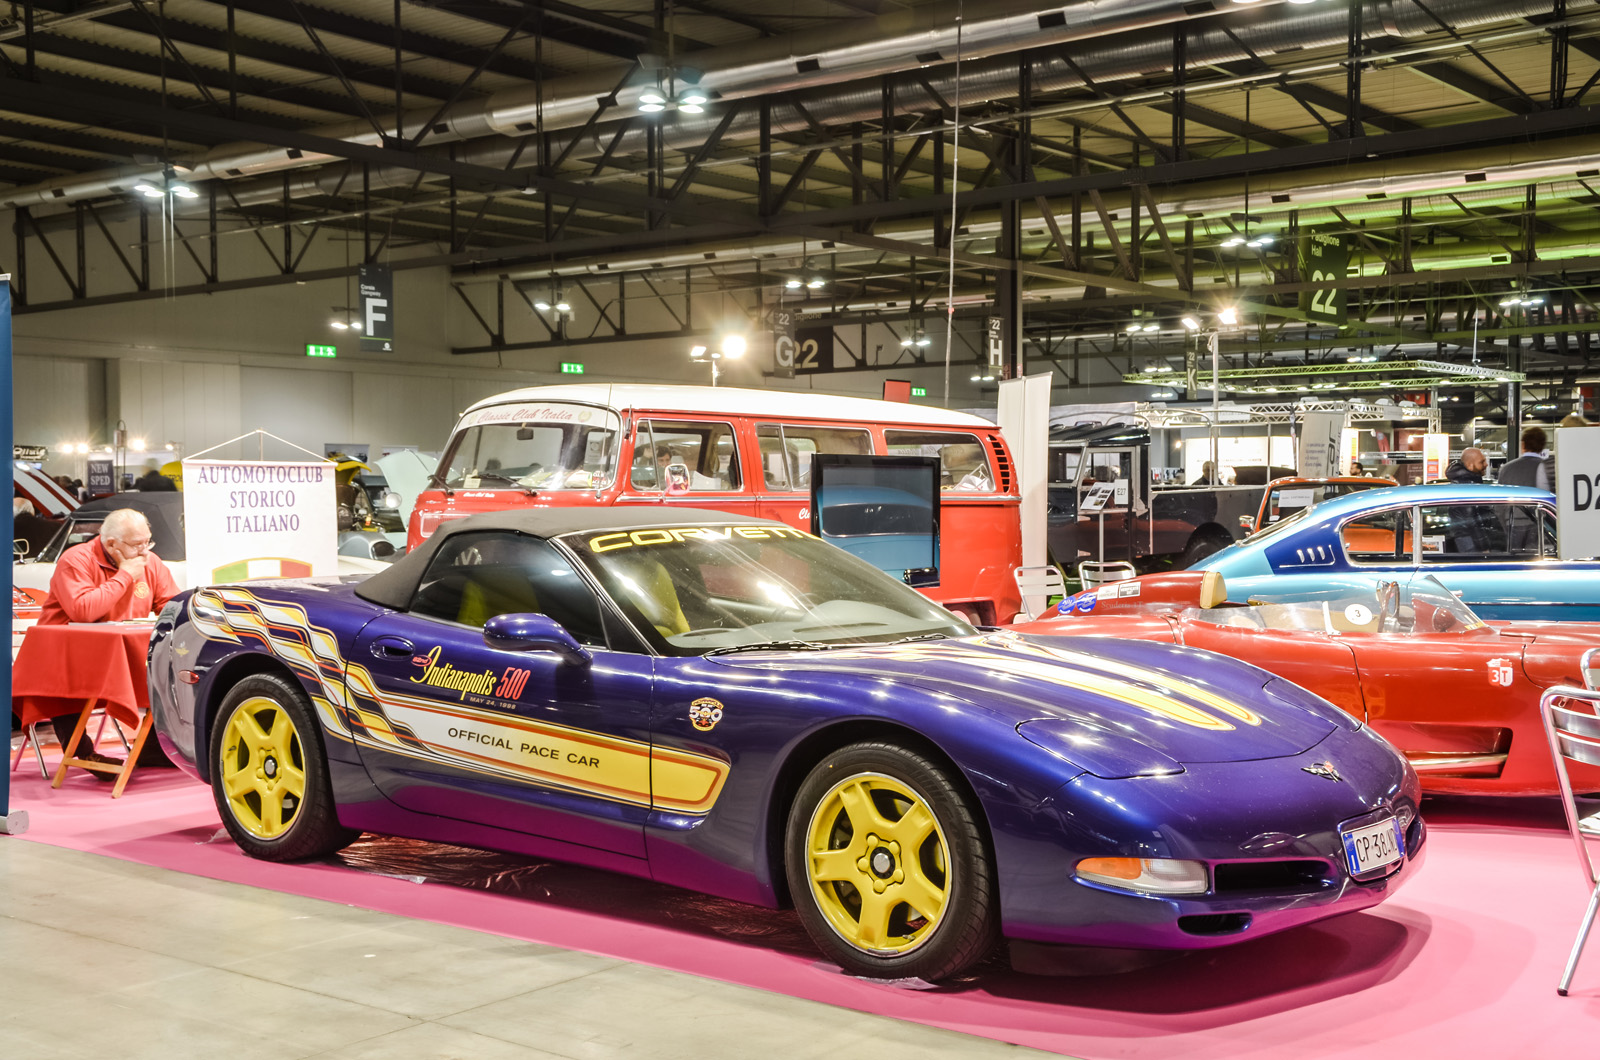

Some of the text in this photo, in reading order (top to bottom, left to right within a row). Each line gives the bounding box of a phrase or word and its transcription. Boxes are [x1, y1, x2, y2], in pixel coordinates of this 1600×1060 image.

[1311, 244, 1323, 257] Hall
[1311, 269, 1337, 315] 22
[365, 297, 388, 336] F
[778, 312, 790, 326] 22
[775, 335, 794, 367] G
[990, 338, 1003, 366] H
[1187, 367, 1197, 392] K
[511, 408, 541, 421] Club
[541, 407, 574, 420] Italia
[90, 463, 109, 474] NEW
[197, 465, 324, 484] AUTOMOTOCLUB
[90, 475, 111, 486] SPED
[230, 490, 296, 509] STORICO
[226, 514, 300, 533] ITALIANO
[1355, 609, 1361, 618] 3
[409, 645, 531, 701] Indianapolis 500
[469, 696, 485, 704] MAY
[447, 727, 600, 768] OFFICIAL PACE CAR
